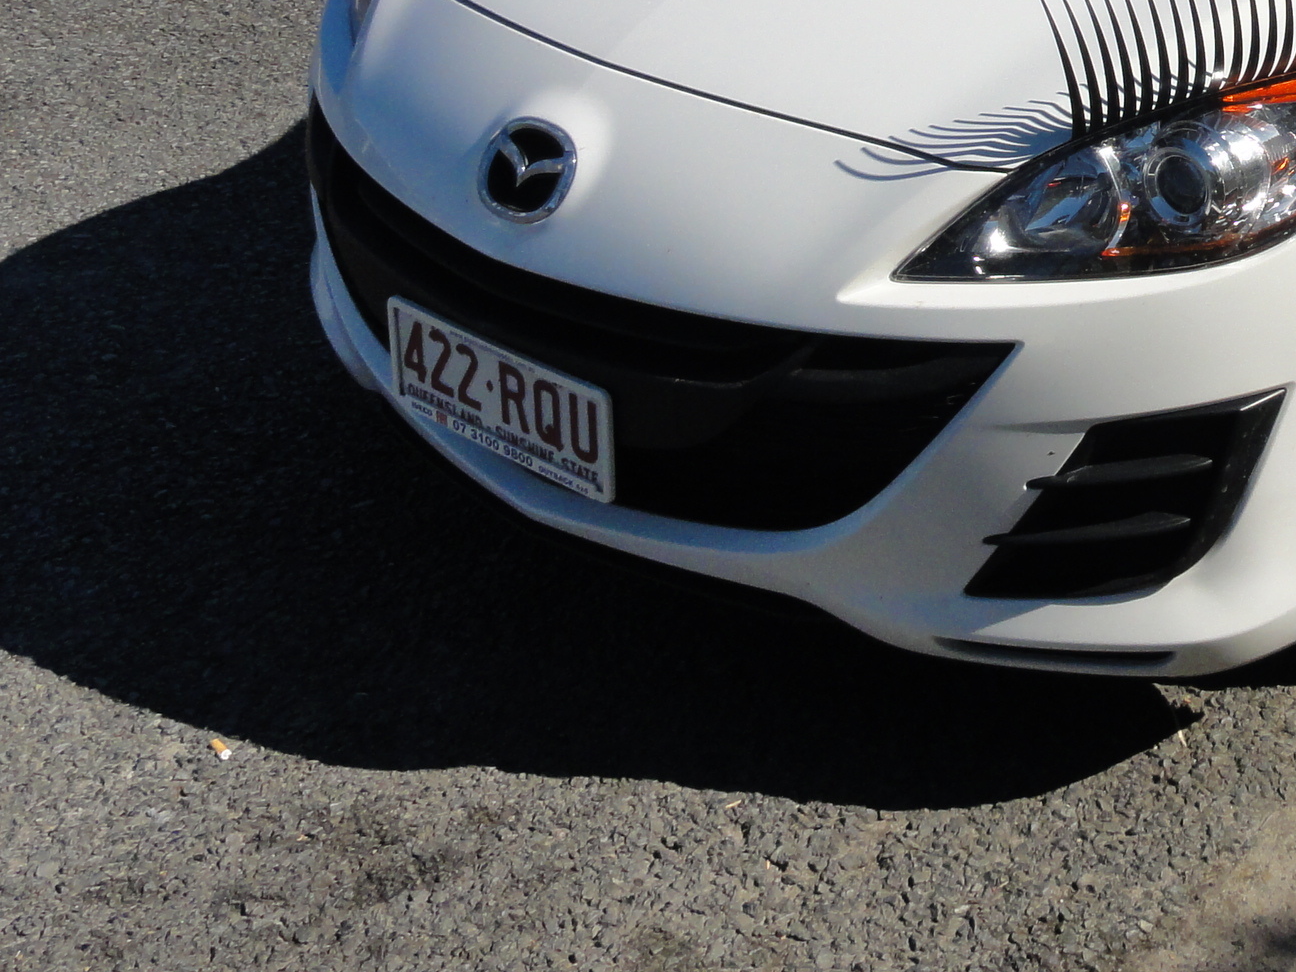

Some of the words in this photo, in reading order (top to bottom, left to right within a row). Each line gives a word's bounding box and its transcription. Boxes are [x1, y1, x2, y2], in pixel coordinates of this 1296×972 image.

[407, 383, 483, 427] QUEENSLAND
[561, 457, 599, 483] STATE
[452, 419, 467, 434] 07
[470, 428, 500, 451] 3100
[503, 444, 534, 468] 9800
